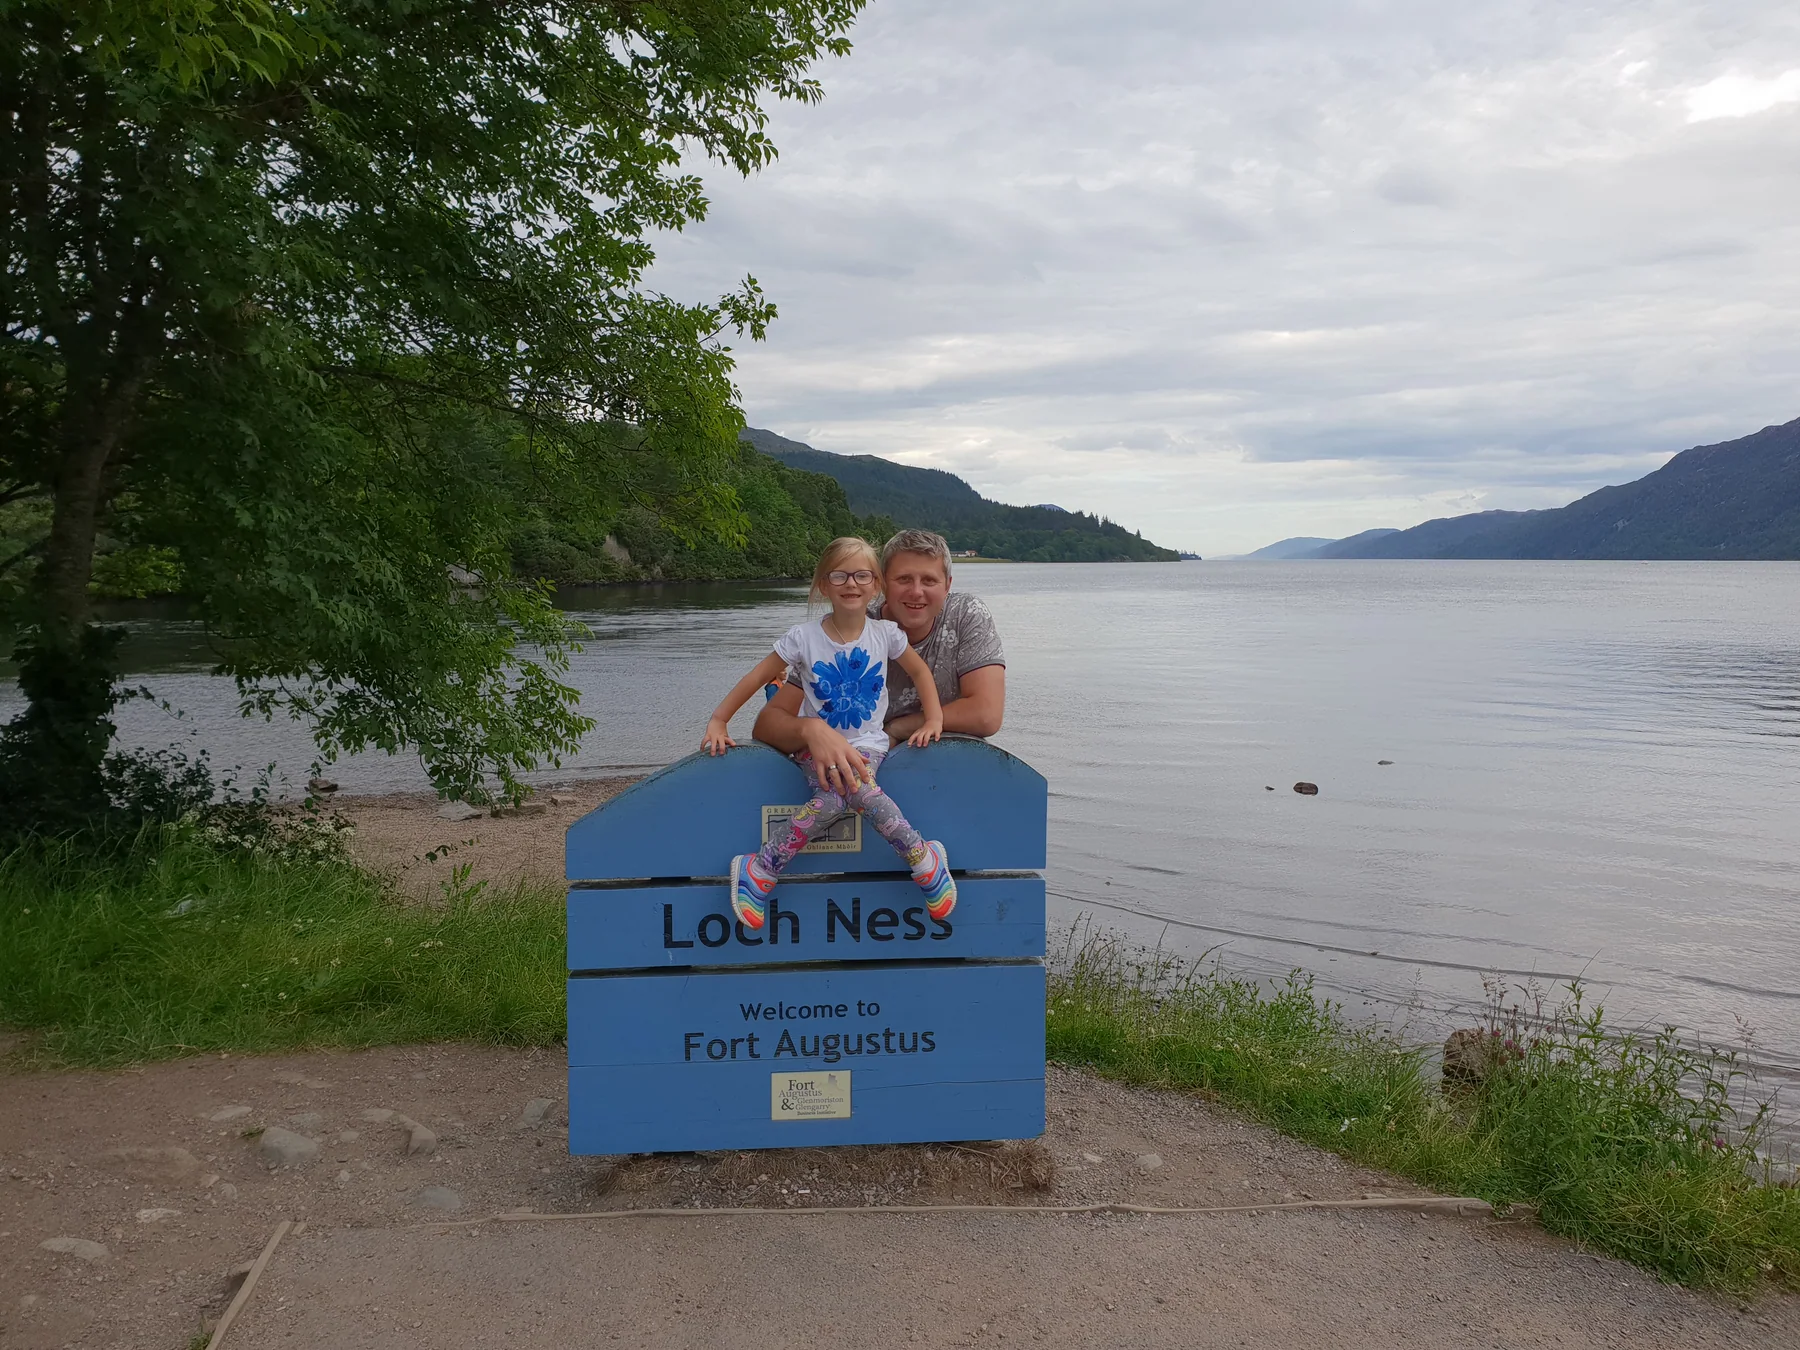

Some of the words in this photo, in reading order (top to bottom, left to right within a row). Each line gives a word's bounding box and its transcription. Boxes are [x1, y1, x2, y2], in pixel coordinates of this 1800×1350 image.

[663, 897, 800, 949] Loch
[826, 896, 953, 943] Ness
[739, 1001, 849, 1021] Welcome
[856, 999, 881, 1017] to
[684, 1032, 761, 1062] Fort
[773, 1027, 936, 1063] Augustus
[788, 1079, 815, 1091] Fort
[778, 1089, 823, 1100] Augustus
[781, 1097, 794, 1111] &
[797, 1096, 844, 1104] Glenmoriston
[795, 1103, 831, 1112] Glengarry
